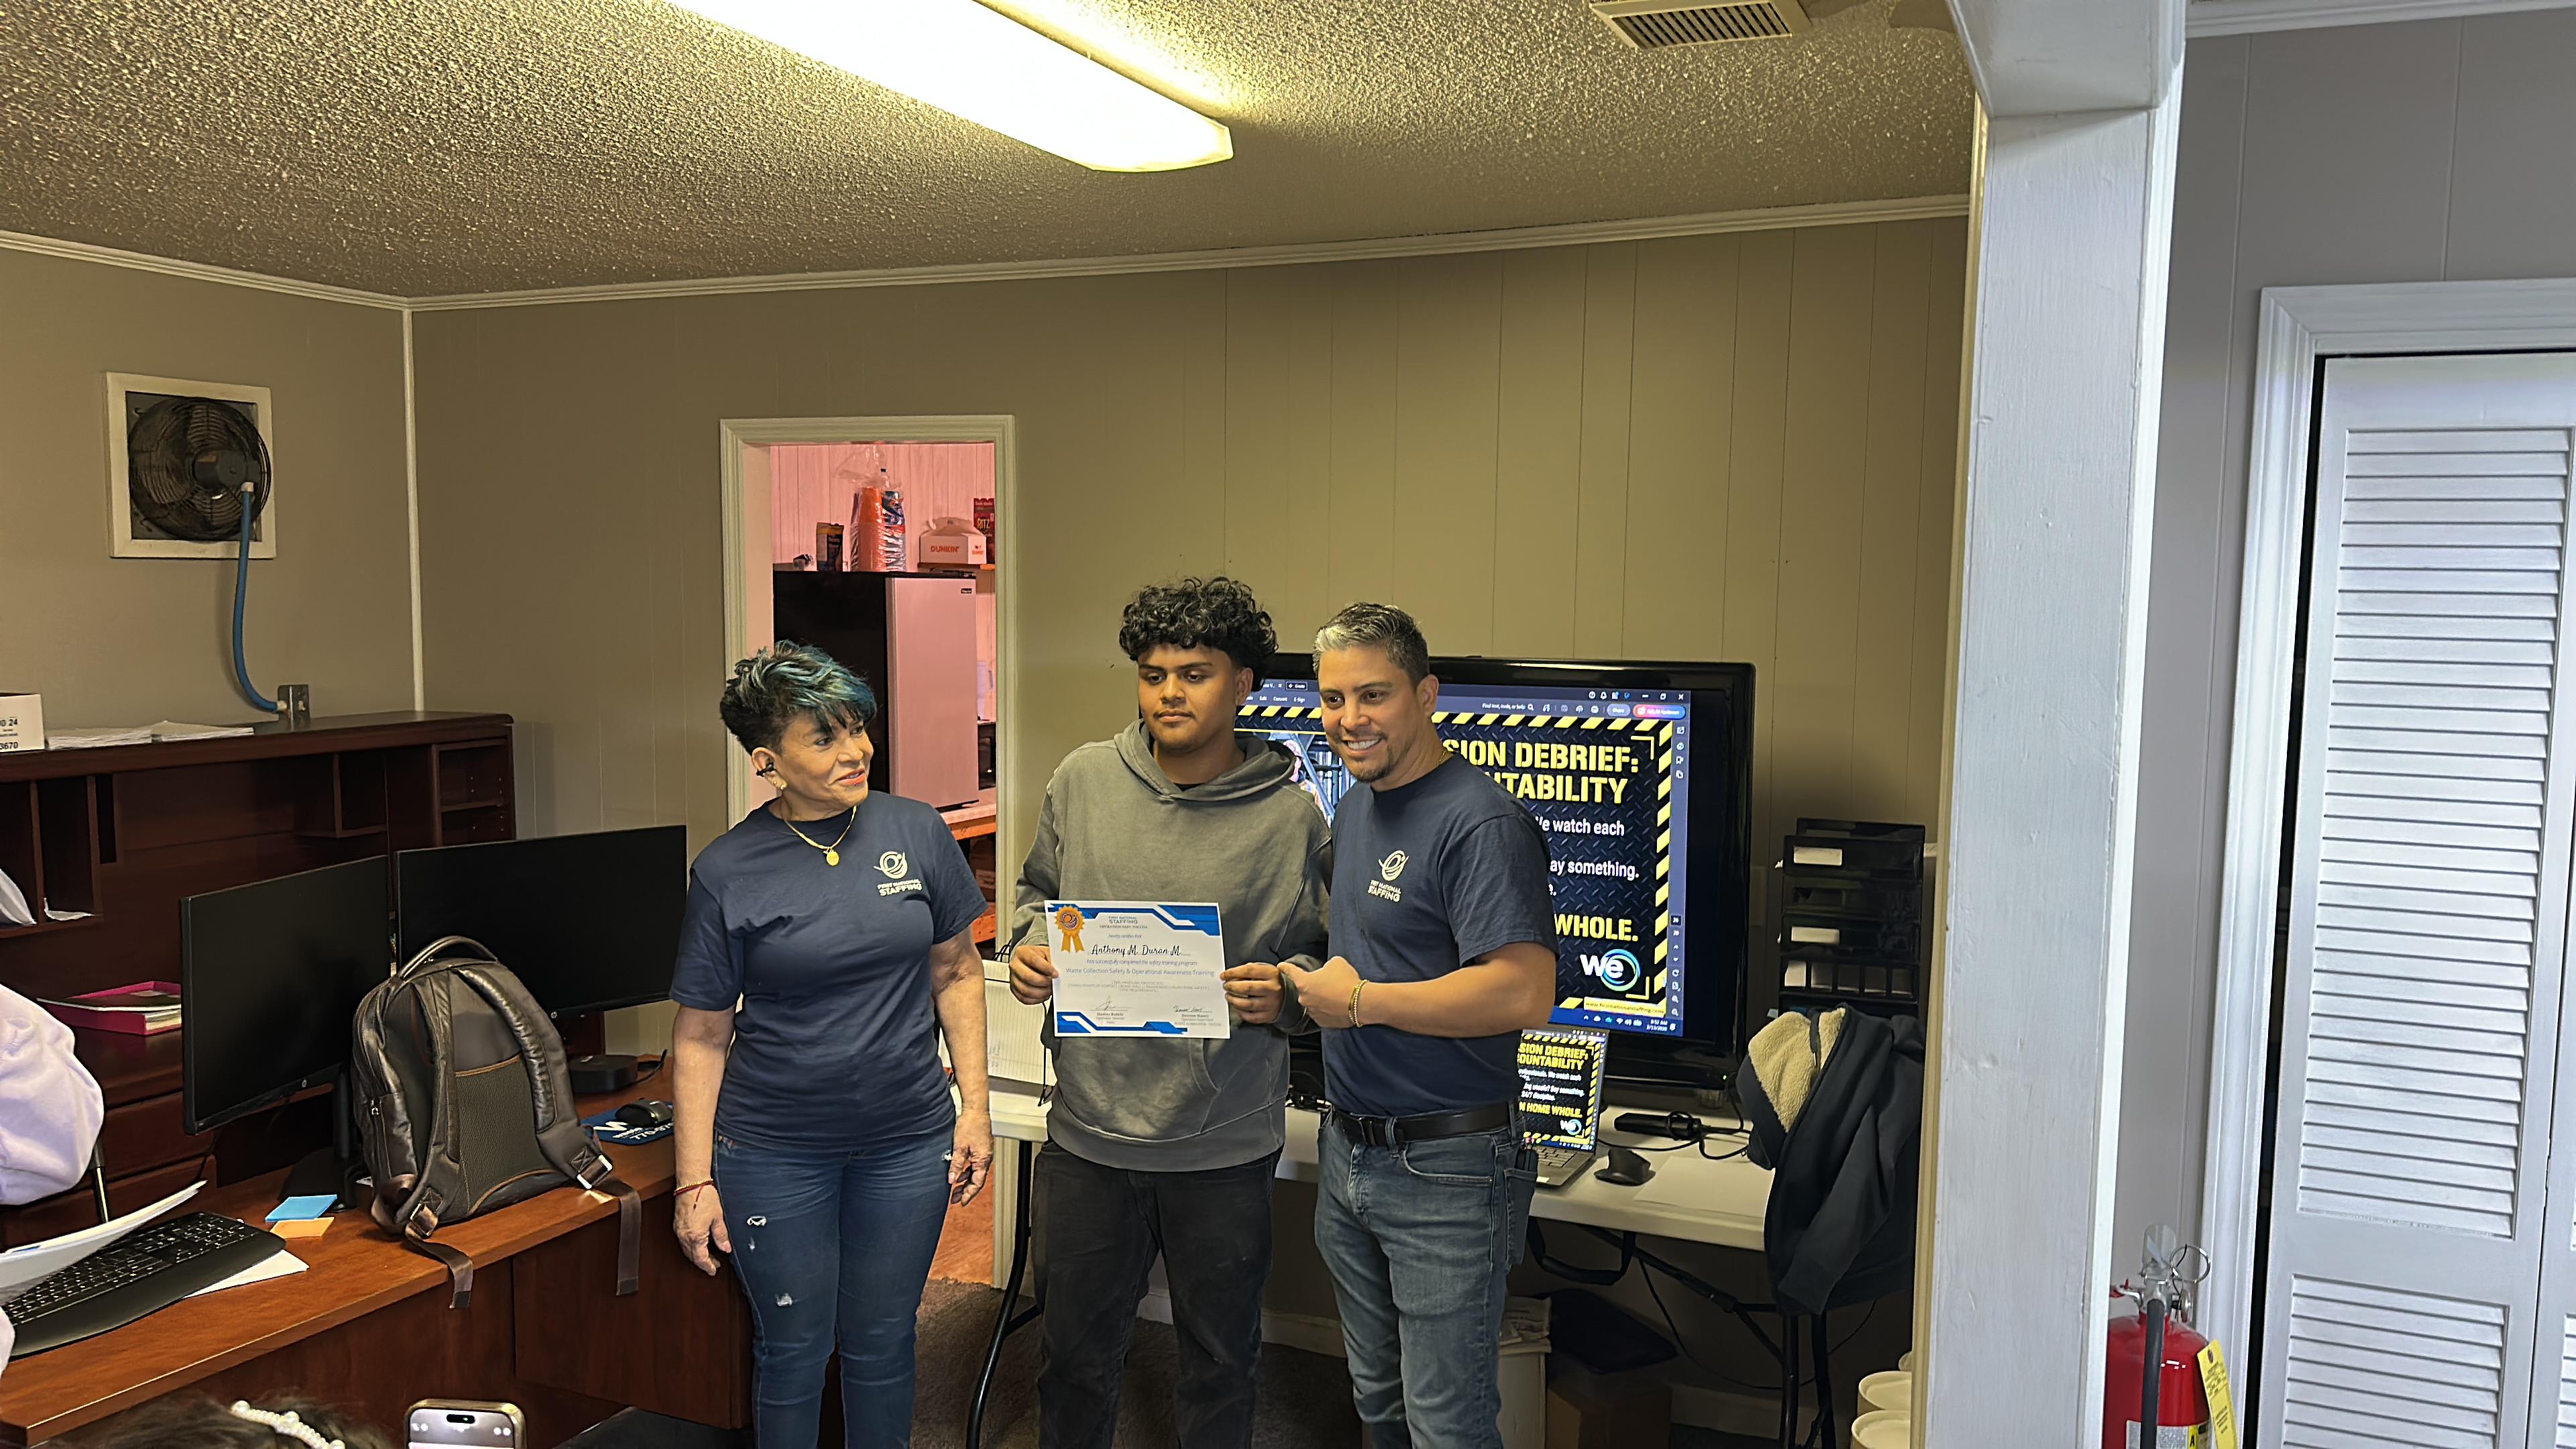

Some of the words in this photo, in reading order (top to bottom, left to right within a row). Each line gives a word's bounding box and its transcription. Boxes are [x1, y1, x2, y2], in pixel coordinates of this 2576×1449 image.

[977, 518, 990, 529] RITZ
[9, 718, 18, 727] 24
[1515, 742, 1638, 773] DEBRIEF:
[1485, 771, 1628, 804] TABILITY
[1553, 818, 1591, 834] watch
[1594, 820, 1625, 836] each
[1567, 861, 1639, 881] something.
[879, 883, 922, 896] STAFFING
[893, 879, 921, 887] NATIONAL
[1378, 882, 1401, 894] NATIONAL
[1368, 885, 1401, 902] STAFFING
[1554, 914, 1638, 942] WHOLE.
[1091, 944, 1126, 957] Anthony
[1127, 945, 1138, 955] M.
[1170, 945, 1181, 956] M.
[1518, 1043, 1544, 1055] SION
[1545, 1046, 1589, 1060] DEBRIEF:
[1526, 1102, 1551, 1115] HOME
[1552, 1106, 1582, 1118] WHOLE.
